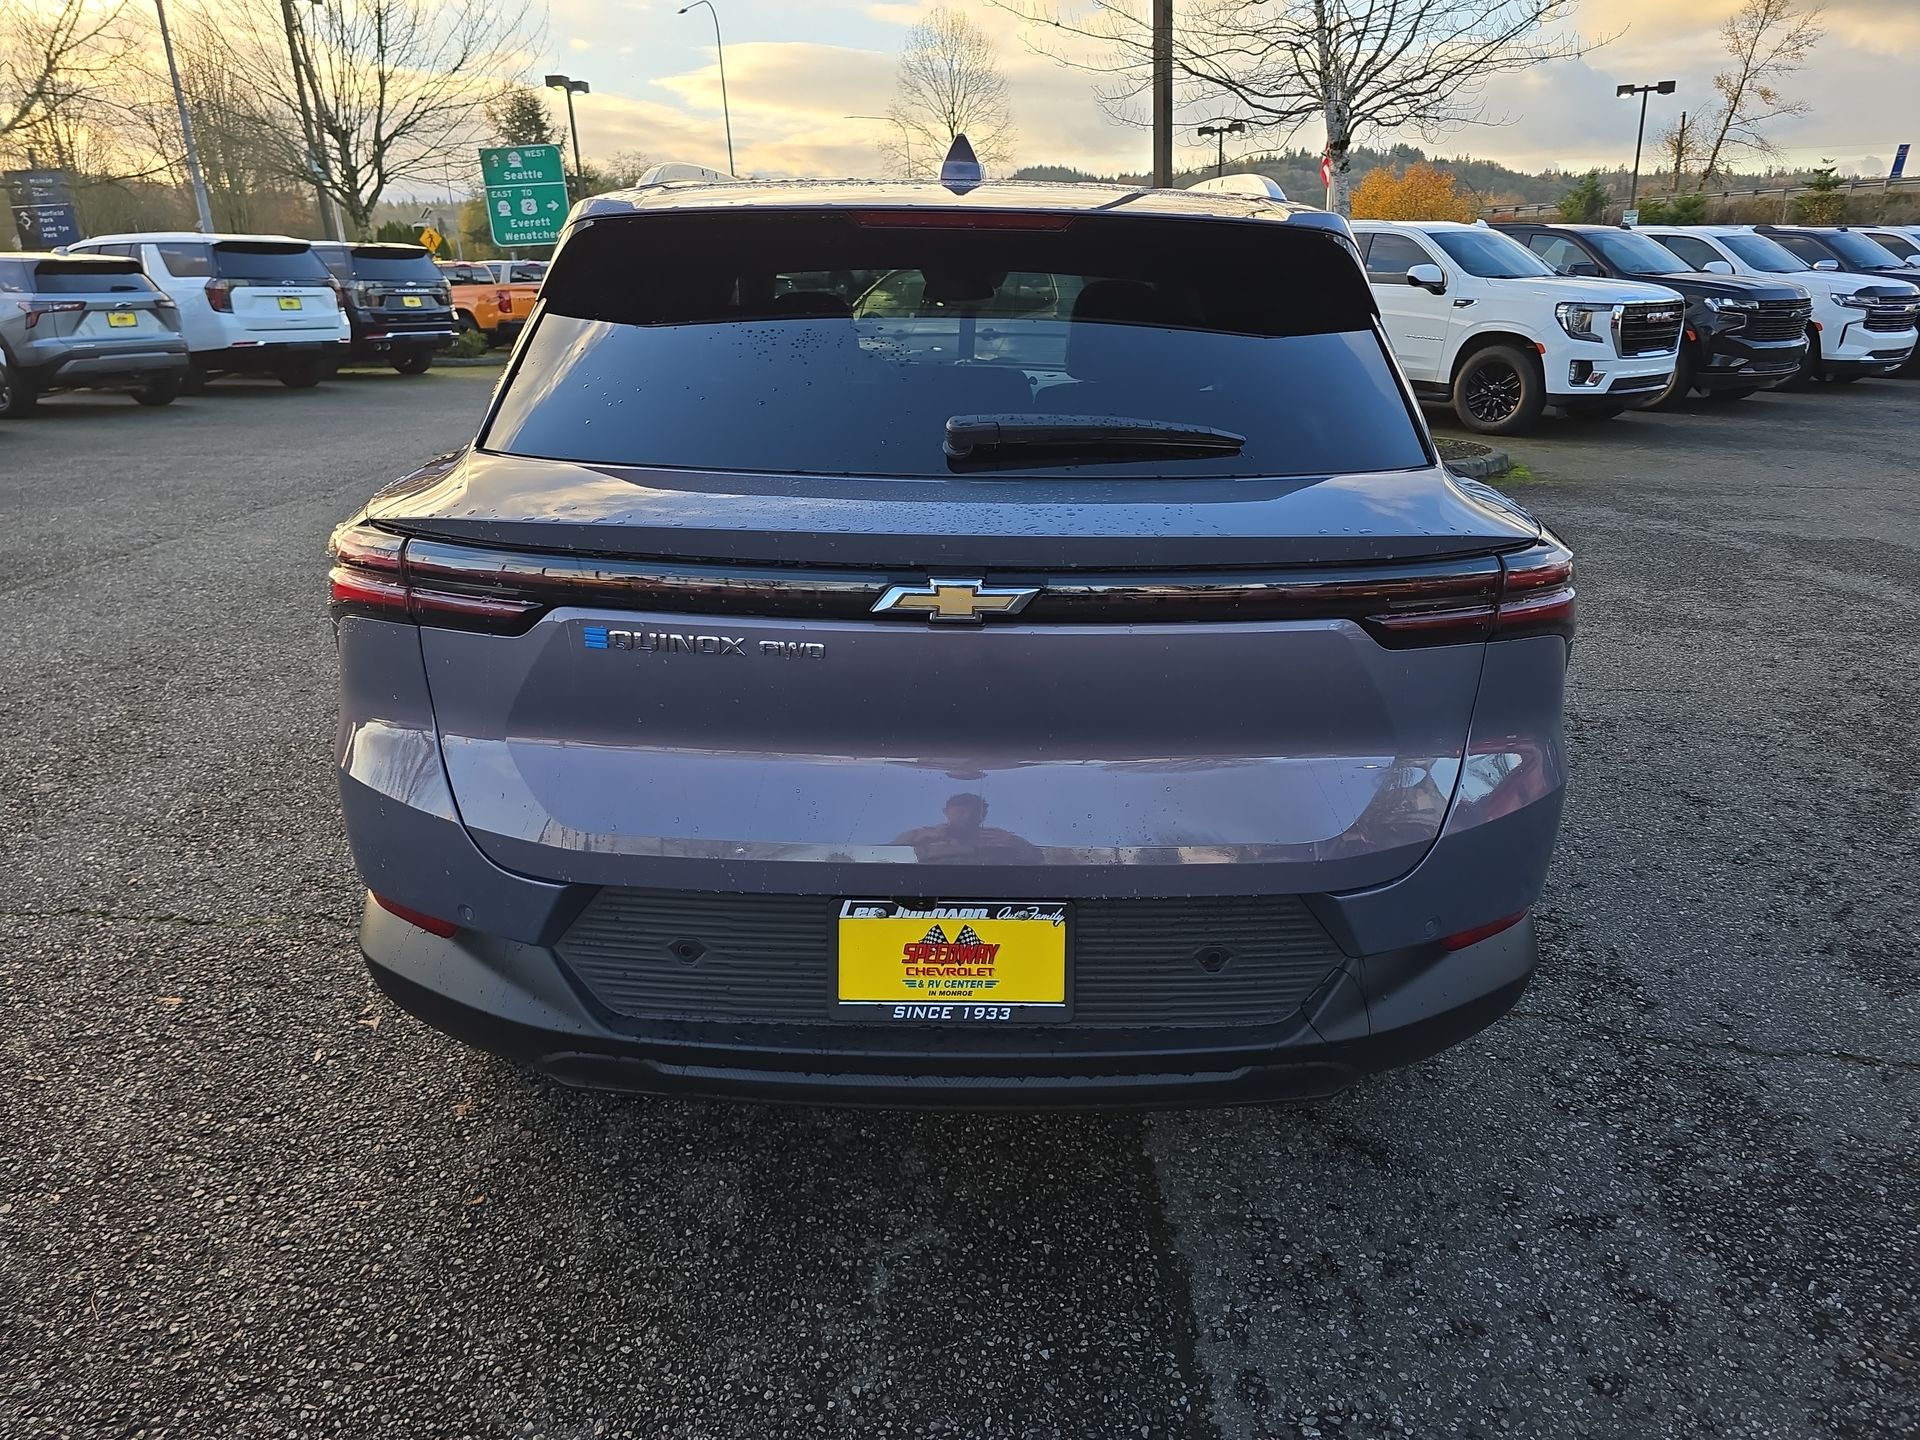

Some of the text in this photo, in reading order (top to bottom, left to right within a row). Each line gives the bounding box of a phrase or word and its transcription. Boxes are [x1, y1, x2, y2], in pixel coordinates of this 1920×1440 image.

[524, 149, 546, 157] WEST
[503, 170, 543, 180] Seattle
[491, 189, 532, 198] EAST TO
[510, 217, 551, 228] Everett
[759, 640, 825, 660] AWD
[996, 906, 1029, 920] Aut
[1027, 906, 1065, 926] Family
[901, 943, 1001, 965] SPEEDWAY
[905, 967, 996, 977] CHEVROLET
[917, 980, 984, 989] & RV CENTER
[893, 1006, 1011, 1020] SINCE 1933
